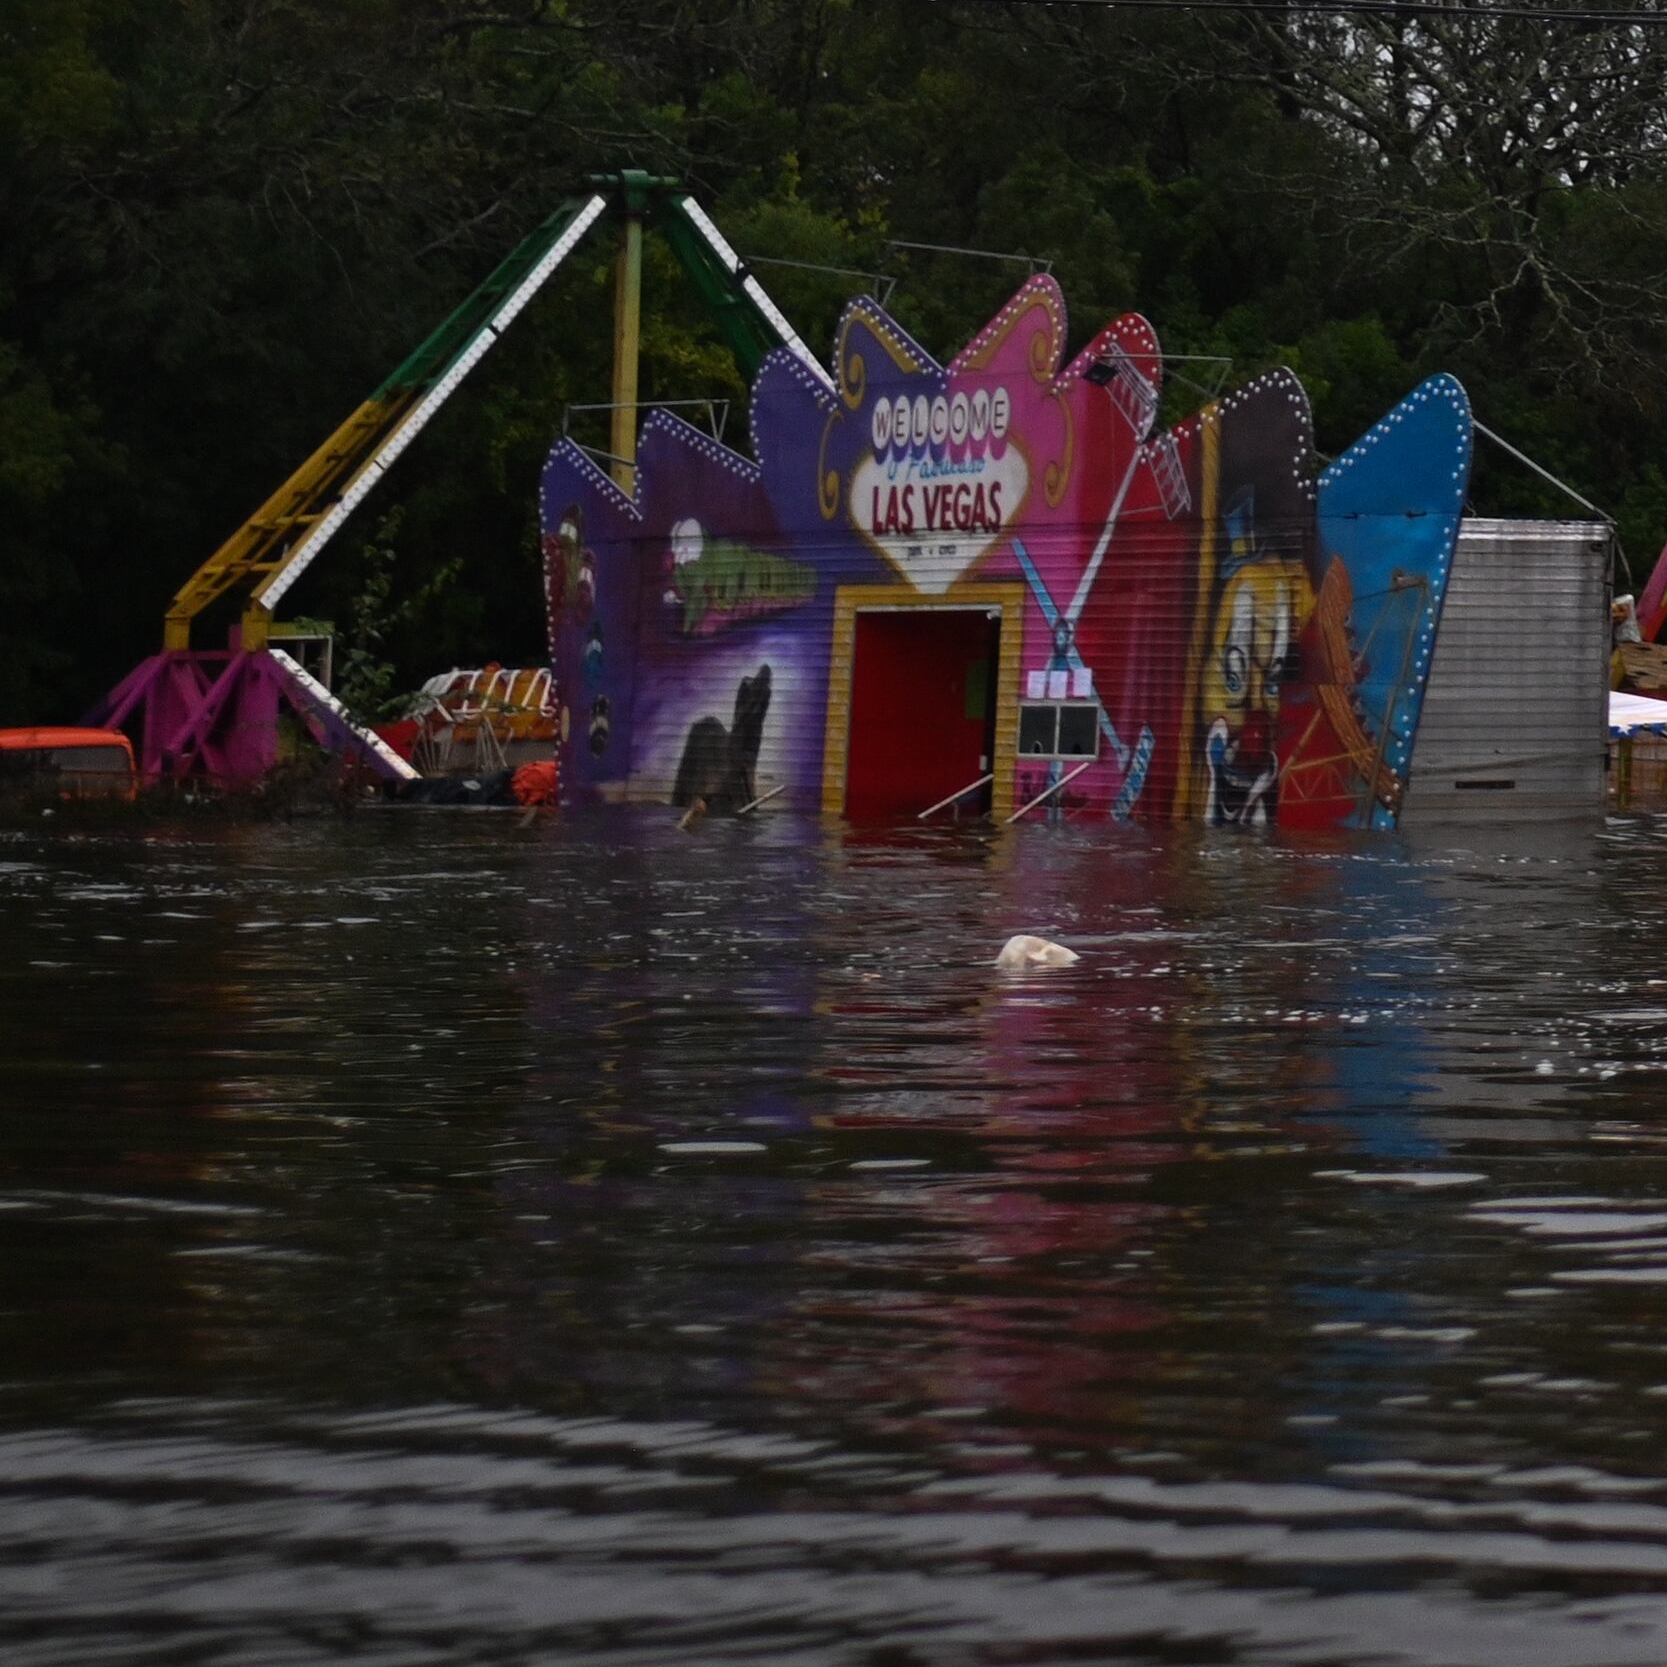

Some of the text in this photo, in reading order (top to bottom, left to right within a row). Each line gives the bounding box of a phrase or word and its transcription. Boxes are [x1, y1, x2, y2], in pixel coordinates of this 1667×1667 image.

[875, 398, 1006, 439] WELCOME
[871, 481, 1003, 535] LAS VEGAS
